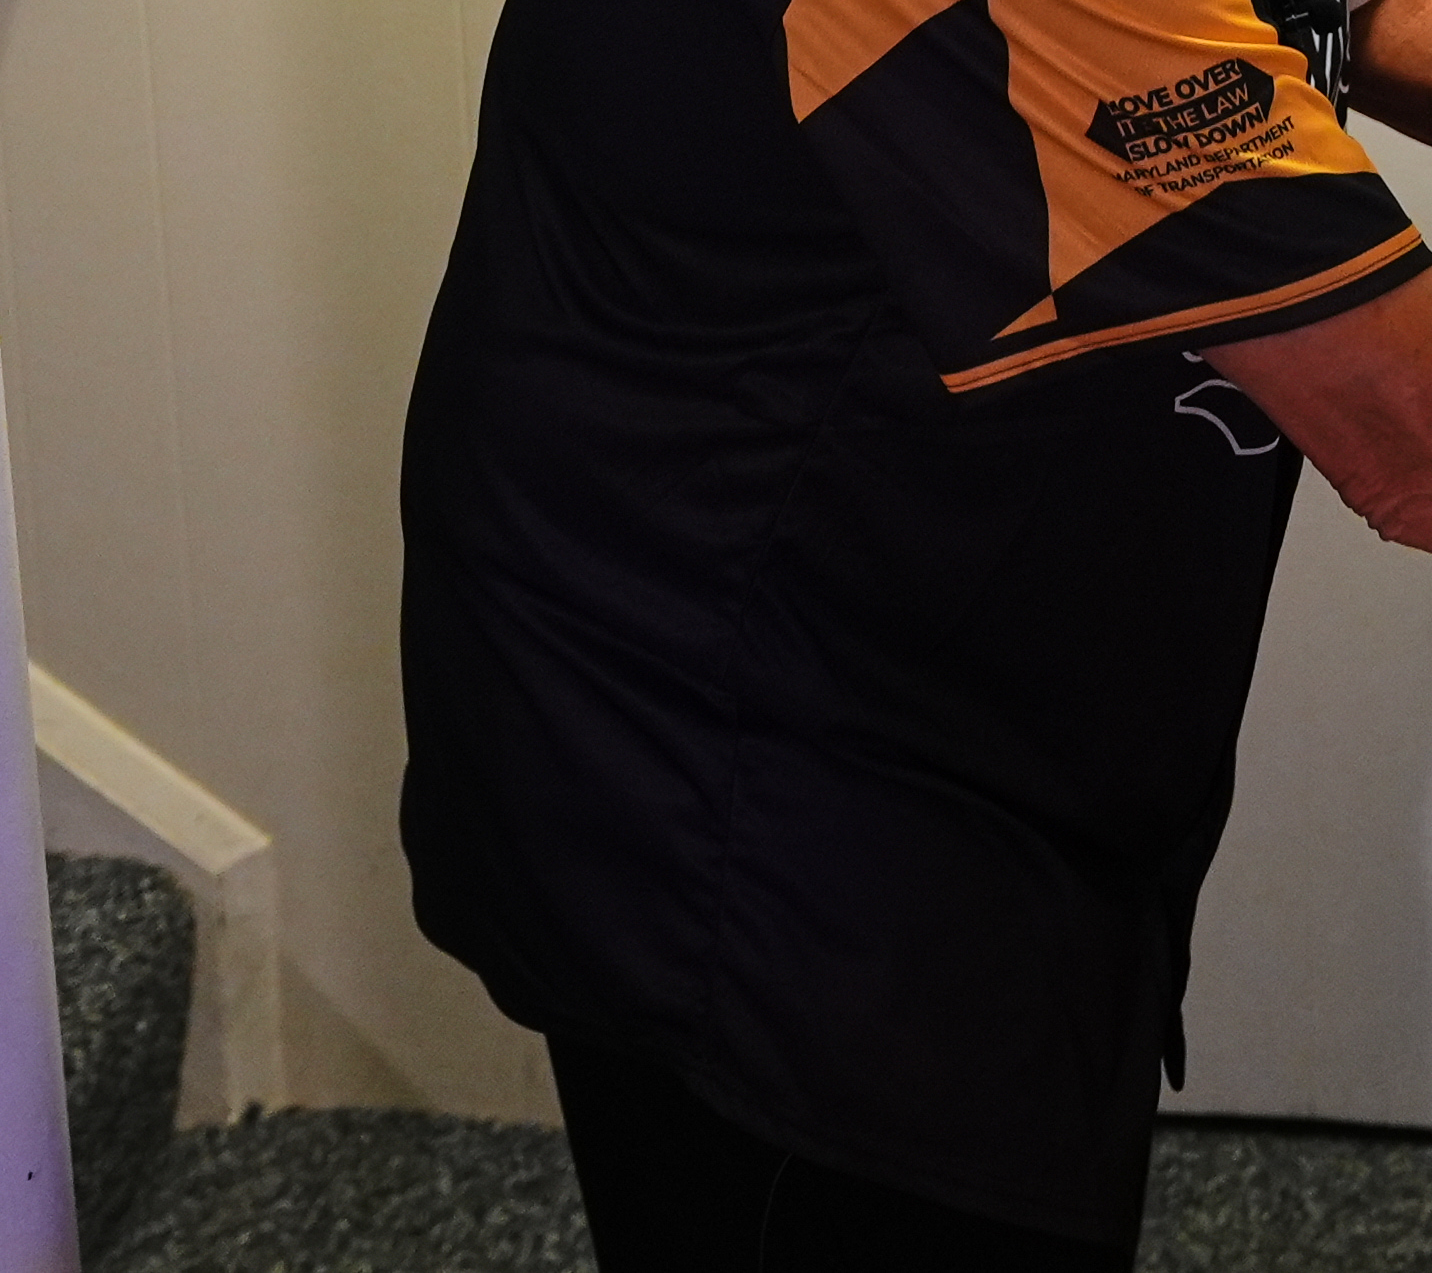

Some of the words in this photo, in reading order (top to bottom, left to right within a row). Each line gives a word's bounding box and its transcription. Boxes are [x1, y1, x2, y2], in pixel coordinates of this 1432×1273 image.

[1174, 58, 1243, 101] OVER
[1152, 109, 1200, 134] THE
[1201, 83, 1249, 120] LAW
[1194, 104, 1265, 149] DOWN
